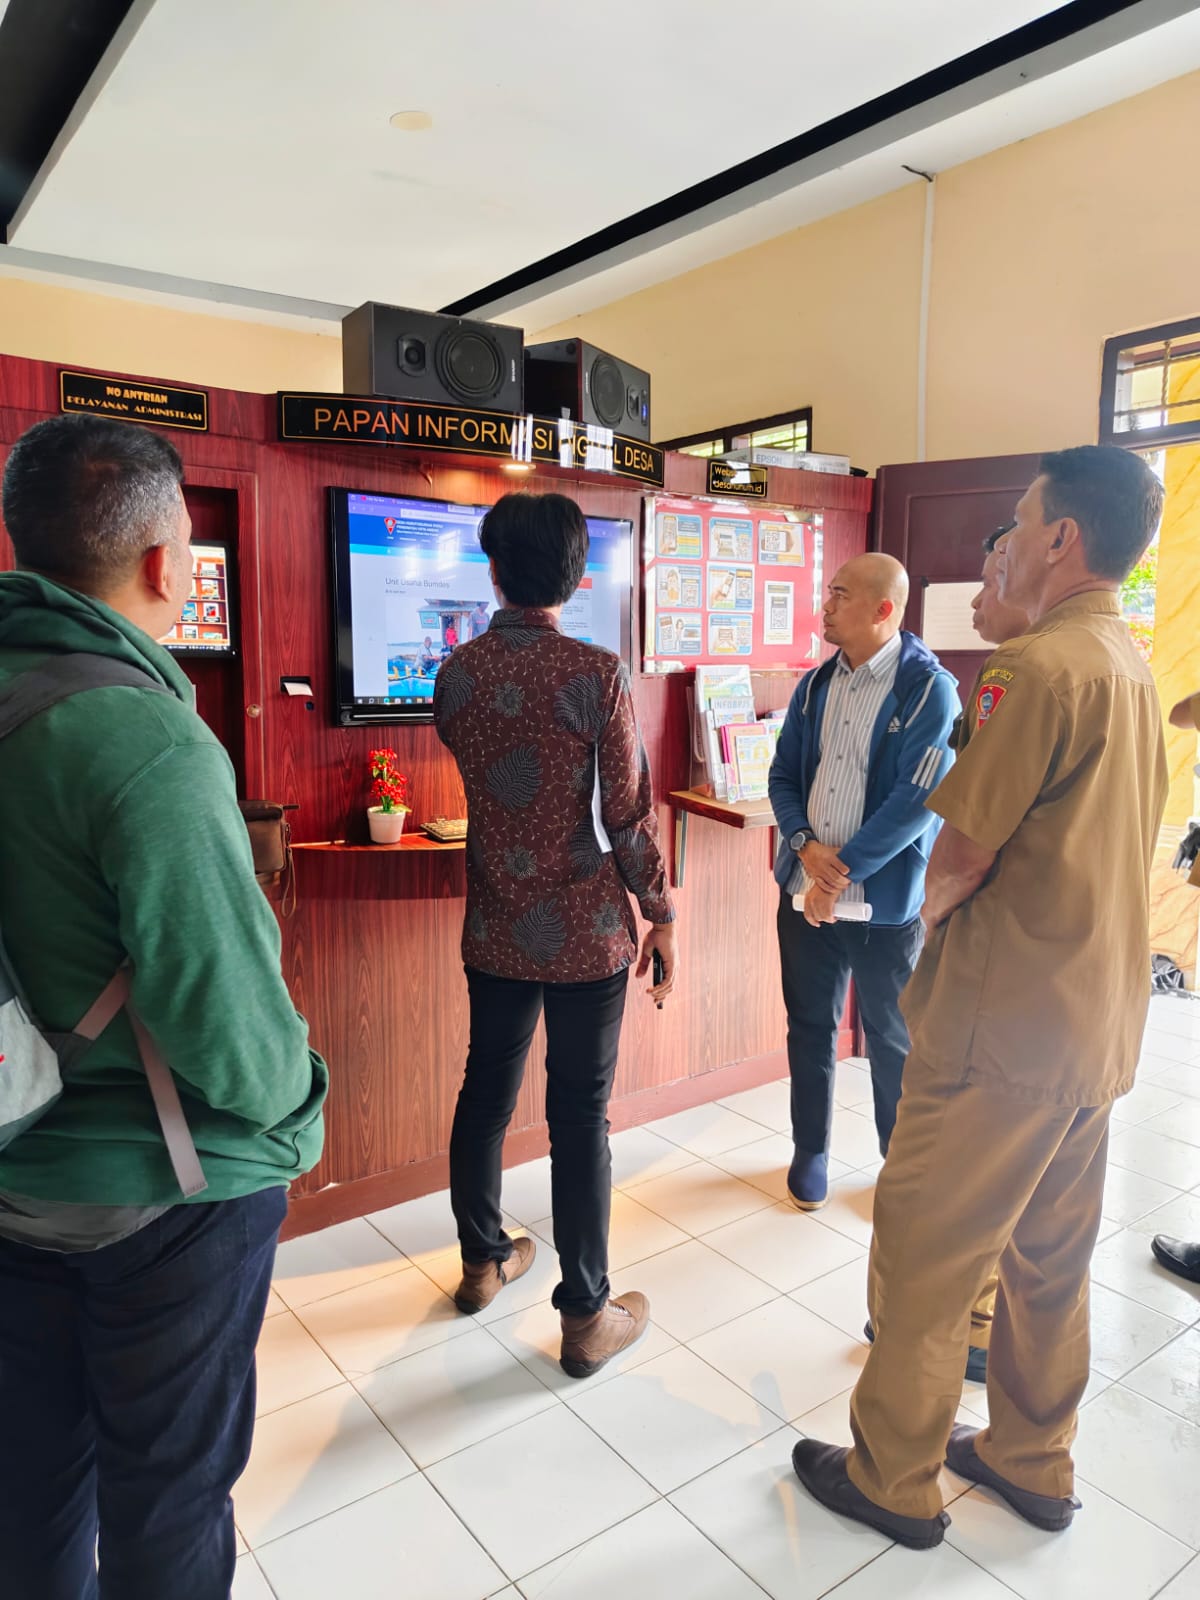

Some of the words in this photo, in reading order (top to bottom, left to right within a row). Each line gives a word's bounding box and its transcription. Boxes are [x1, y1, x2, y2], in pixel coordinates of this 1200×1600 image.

[106, 386, 121, 397] NO
[123, 387, 168, 404] ANTRIAN
[67, 395, 129, 411] PELAYANAN
[134, 405, 203, 421] ADMINISTRASI
[315, 408, 409, 435] PAPAN
[625, 447, 655, 473] DESA
[755, 453, 783, 466] EPSON
